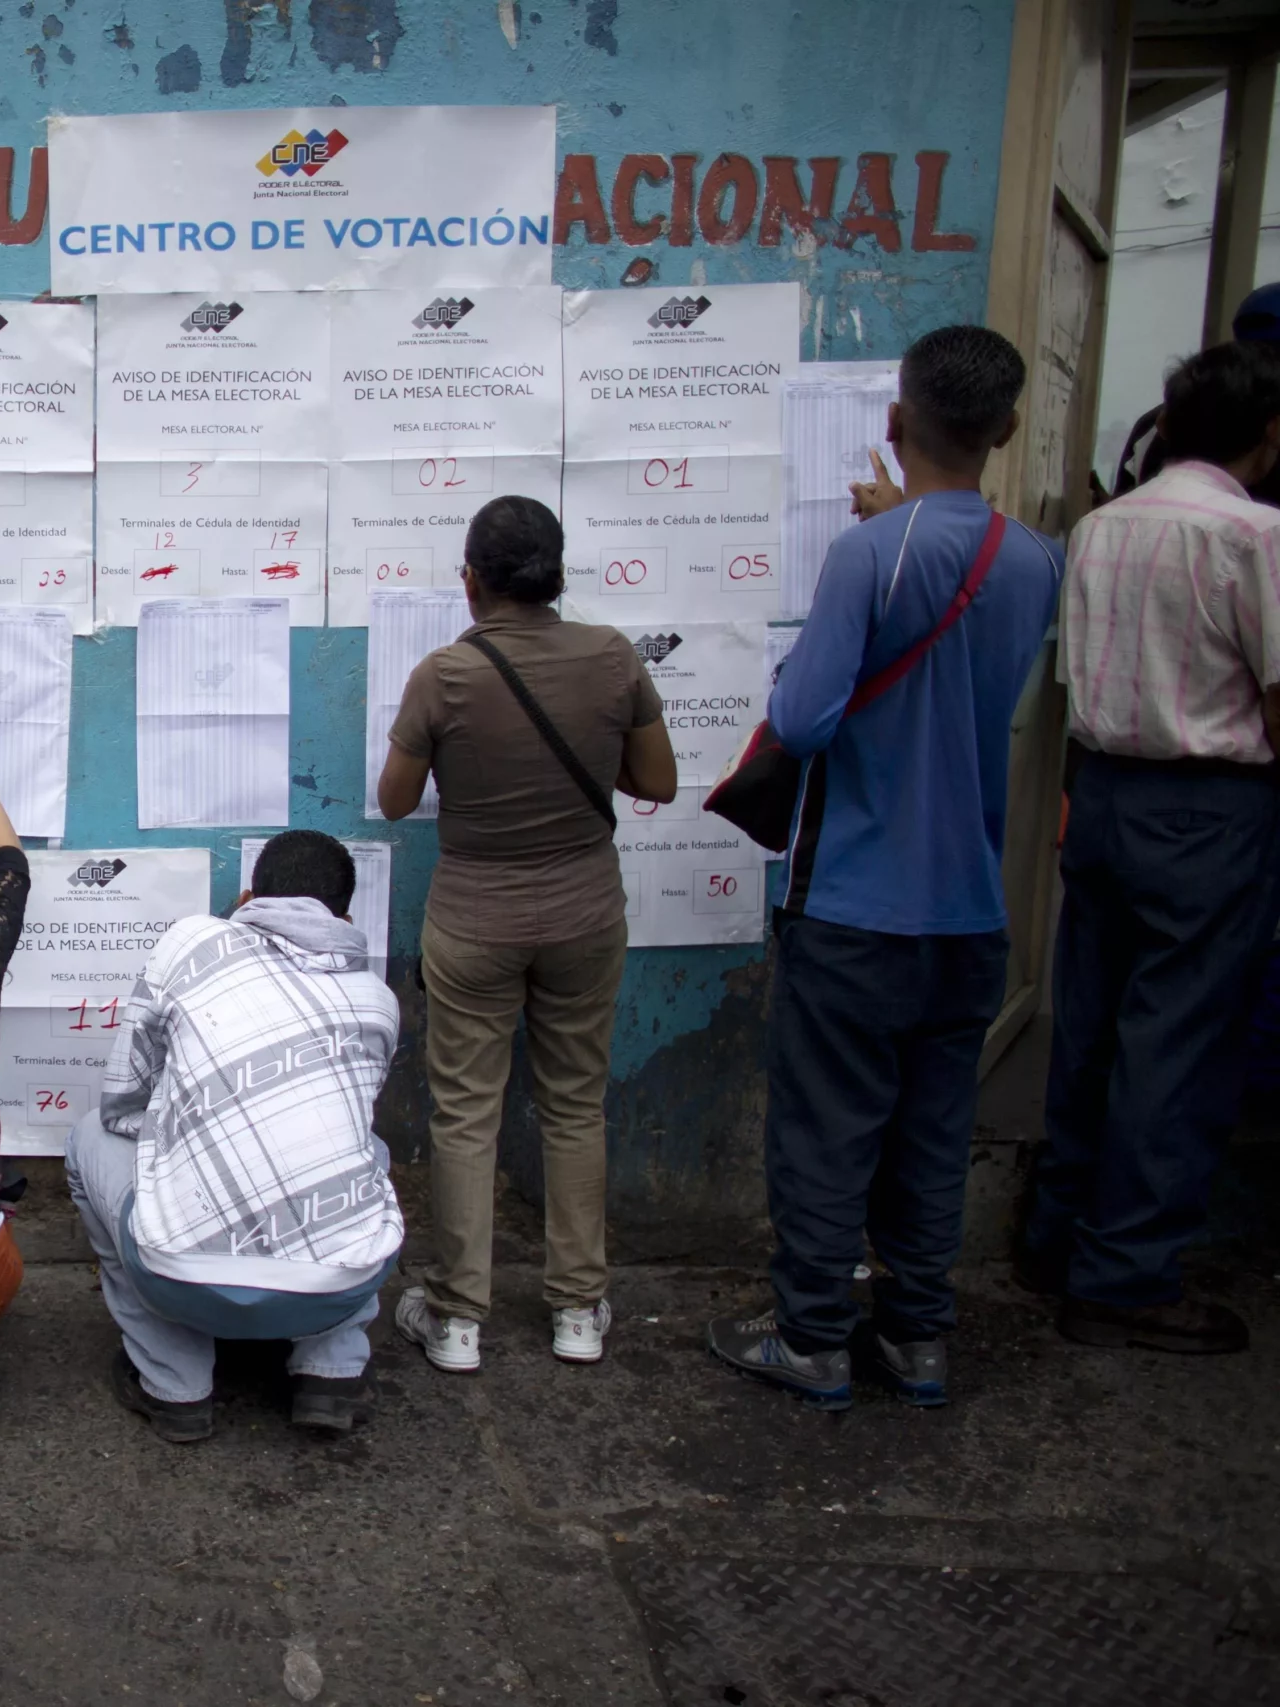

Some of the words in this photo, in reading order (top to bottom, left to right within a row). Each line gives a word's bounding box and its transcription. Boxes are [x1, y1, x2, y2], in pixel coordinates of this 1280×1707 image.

[258, 180, 290, 188] PODER
[253, 191, 274, 199] Junta
[313, 189, 348, 197] Electoral
[553, 150, 975, 252] ACIONAL
[58, 220, 236, 256] CENTRO
[252, 220, 305, 250] DE
[325, 208, 549, 248] VOTACIÓN
[112, 371, 155, 383] AVISO
[161, 371, 180, 383] DE
[186, 370, 311, 382] IDENTIFICACIÓN
[343, 369, 387, 381] AVISO
[393, 368, 412, 380] DE
[418, 365, 543, 379] IDENTIFICACIÓN
[580, 368, 623, 381] AVISO
[629, 367, 648, 380] DE
[654, 363, 779, 378] IDENTIFICACIÓN
[124, 389, 142, 401] DE
[148, 389, 166, 401] LA
[172, 389, 209, 401] MESA
[215, 388, 300, 400] ELECTORAL
[354, 388, 374, 400] DE
[380, 387, 398, 399] LA
[404, 386, 442, 398] MESA
[447, 384, 533, 397] ELECTORAL
[591, 387, 610, 399] DE
[616, 387, 633, 398] LA
[639, 385, 677, 397] MESA
[682, 382, 769, 396] ELECTORAL
[182, 462, 203, 493] 3
[419, 458, 466, 487] 02
[643, 458, 694, 488] 01
[120, 517, 175, 528] Terminales
[179, 518, 191, 528] de
[196, 517, 231, 527] Cédula
[236, 517, 248, 527] de
[252, 517, 300, 528] Identidad
[352, 517, 407, 527] Terminales
[412, 516, 424, 526] de
[428, 515, 465, 525] Cédula
[586, 516, 641, 527] Terminales
[646, 516, 658, 526] de
[663, 515, 700, 525] Cédula
[704, 514, 716, 524] de
[720, 513, 768, 523] Identidad
[2, 527, 14, 537] de
[18, 527, 66, 537] Identidad
[155, 532, 176, 549] 12
[101, 566, 131, 576] Desde:
[222, 566, 248, 577] Hasta:
[334, 566, 364, 576] Desde:
[376, 562, 409, 581] 06
[567, 566, 597, 576] Desde:
[604, 559, 647, 586] 00
[689, 564, 716, 574] Hasta:
[620, 843, 631, 852] de
[635, 841, 671, 851] Cédula
[675, 841, 687, 850] de
[691, 839, 738, 849] Identidad
[661, 887, 688, 898] Hasta:
[707, 875, 737, 897] 50
[38, 939, 54, 950] LA
[60, 939, 96, 950] MESA
[51, 972, 75, 981] MESA
[79, 972, 132, 981] ELECTORAL
[67, 996, 121, 1031] 11
[13, 1055, 65, 1065] Terminales
[69, 1056, 81, 1066] de
[36, 1091, 69, 1111] 76
